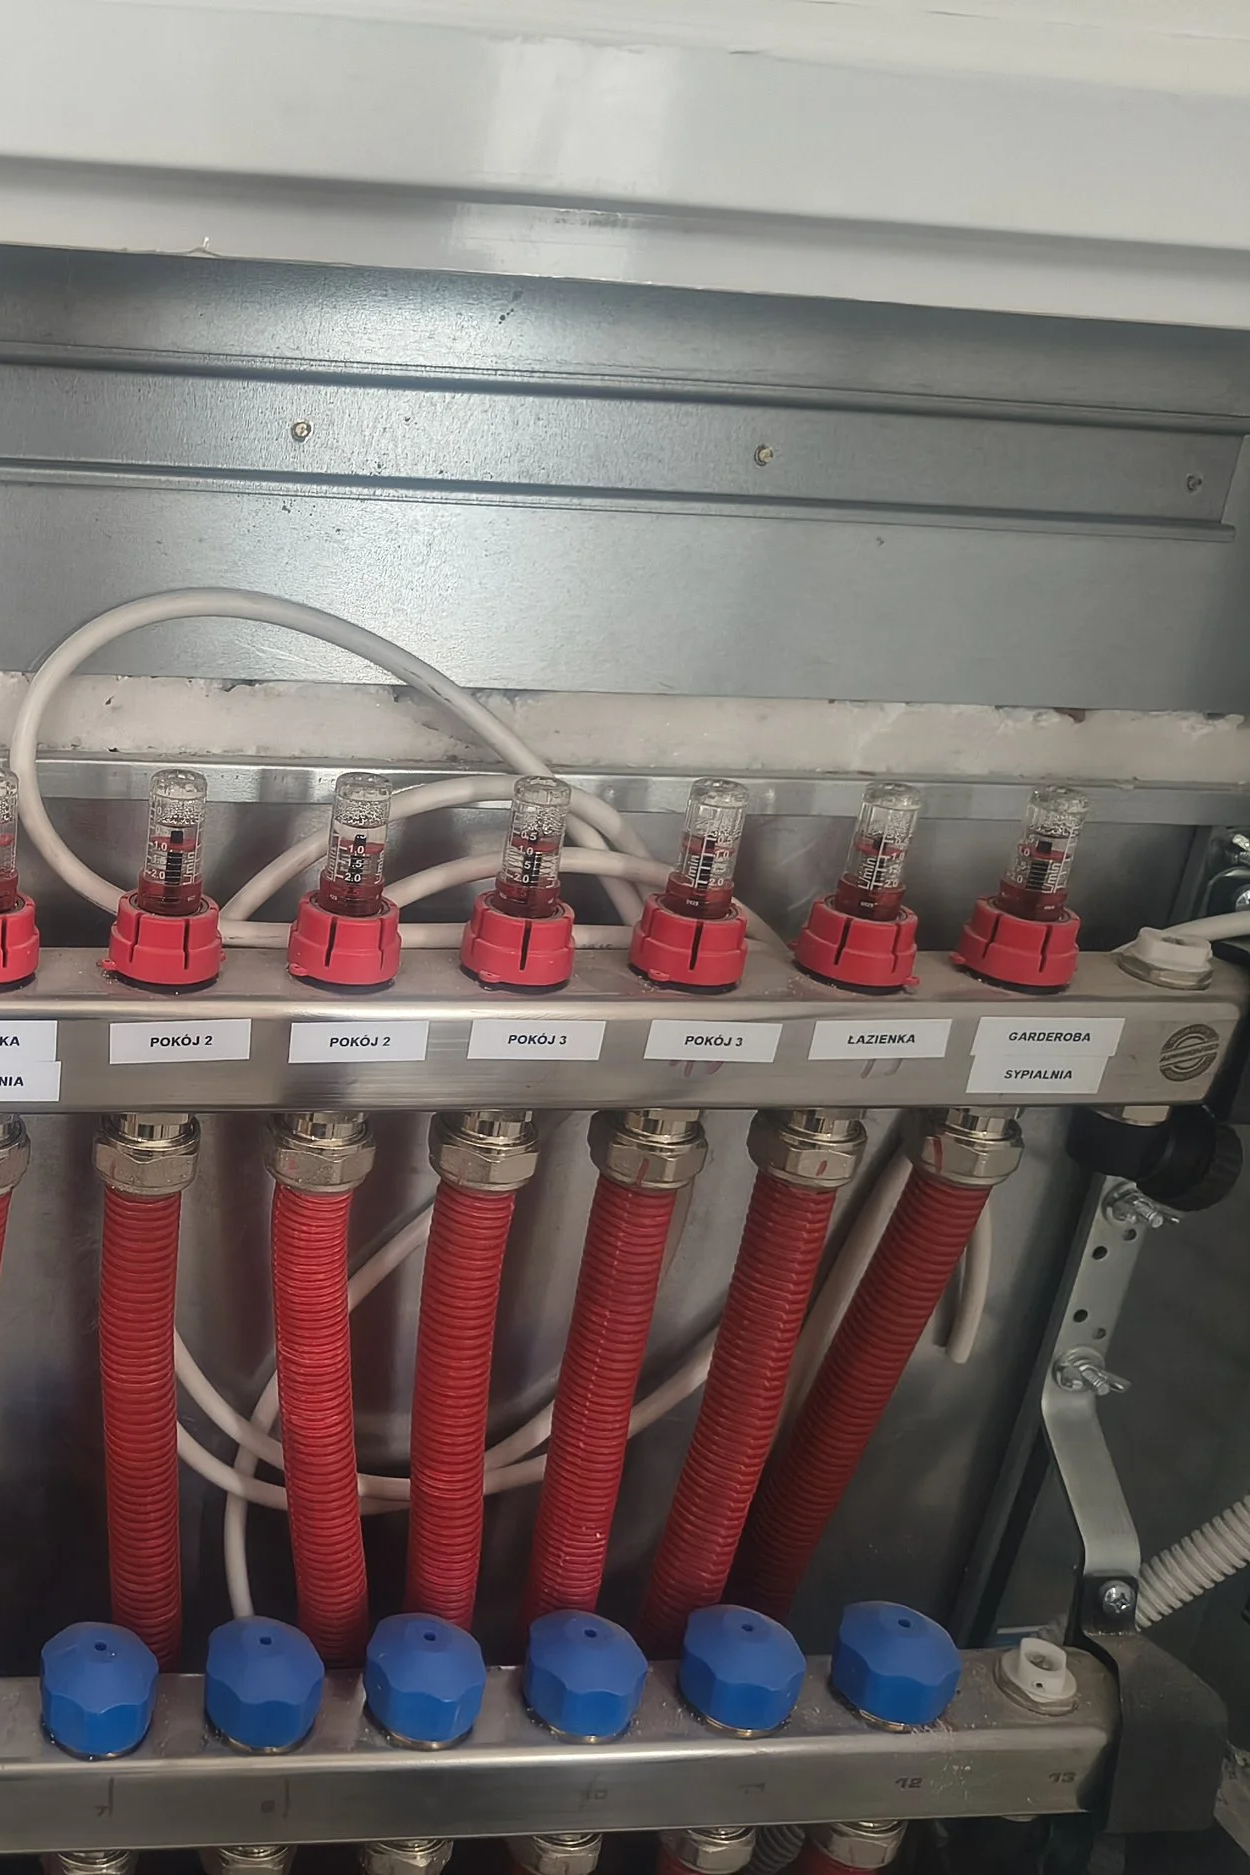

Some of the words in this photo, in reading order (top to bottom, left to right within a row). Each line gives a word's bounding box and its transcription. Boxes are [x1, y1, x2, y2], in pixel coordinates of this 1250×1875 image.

[520, 830, 538, 841] 0.5
[154, 841, 168, 852] 1.0
[348, 845, 365, 855] 1.0
[182, 851, 195, 886] L/min
[347, 858, 363, 868] 1.5
[151, 869, 166, 880] 2.0
[681, 854, 700, 888] L/min
[858, 857, 876, 890] L/min
[1041, 859, 1062, 893] L/min
[344, 872, 362, 882] 2.0
[513, 872, 530, 883] 2.0
[708, 876, 724, 887] 2.0
[150, 1033, 200, 1048] POKÓJ
[204, 1035, 213, 1046] 2
[329, 1034, 379, 1048] POKÓJ
[382, 1036, 391, 1047] 2
[507, 1032, 555, 1046] POKÓJ
[558, 1035, 567, 1046] 3
[684, 1034, 732, 1047] POKÓJ
[735, 1037, 743, 1047] 3
[847, 1034, 916, 1045] ŁAZIENKA
[1008, 1031, 1091, 1042] GARDEROBA
[1004, 1069, 1073, 1080] SYPIALNIA
[1049, 1771, 1077, 1783] 13
[895, 1777, 923, 1789] 12
